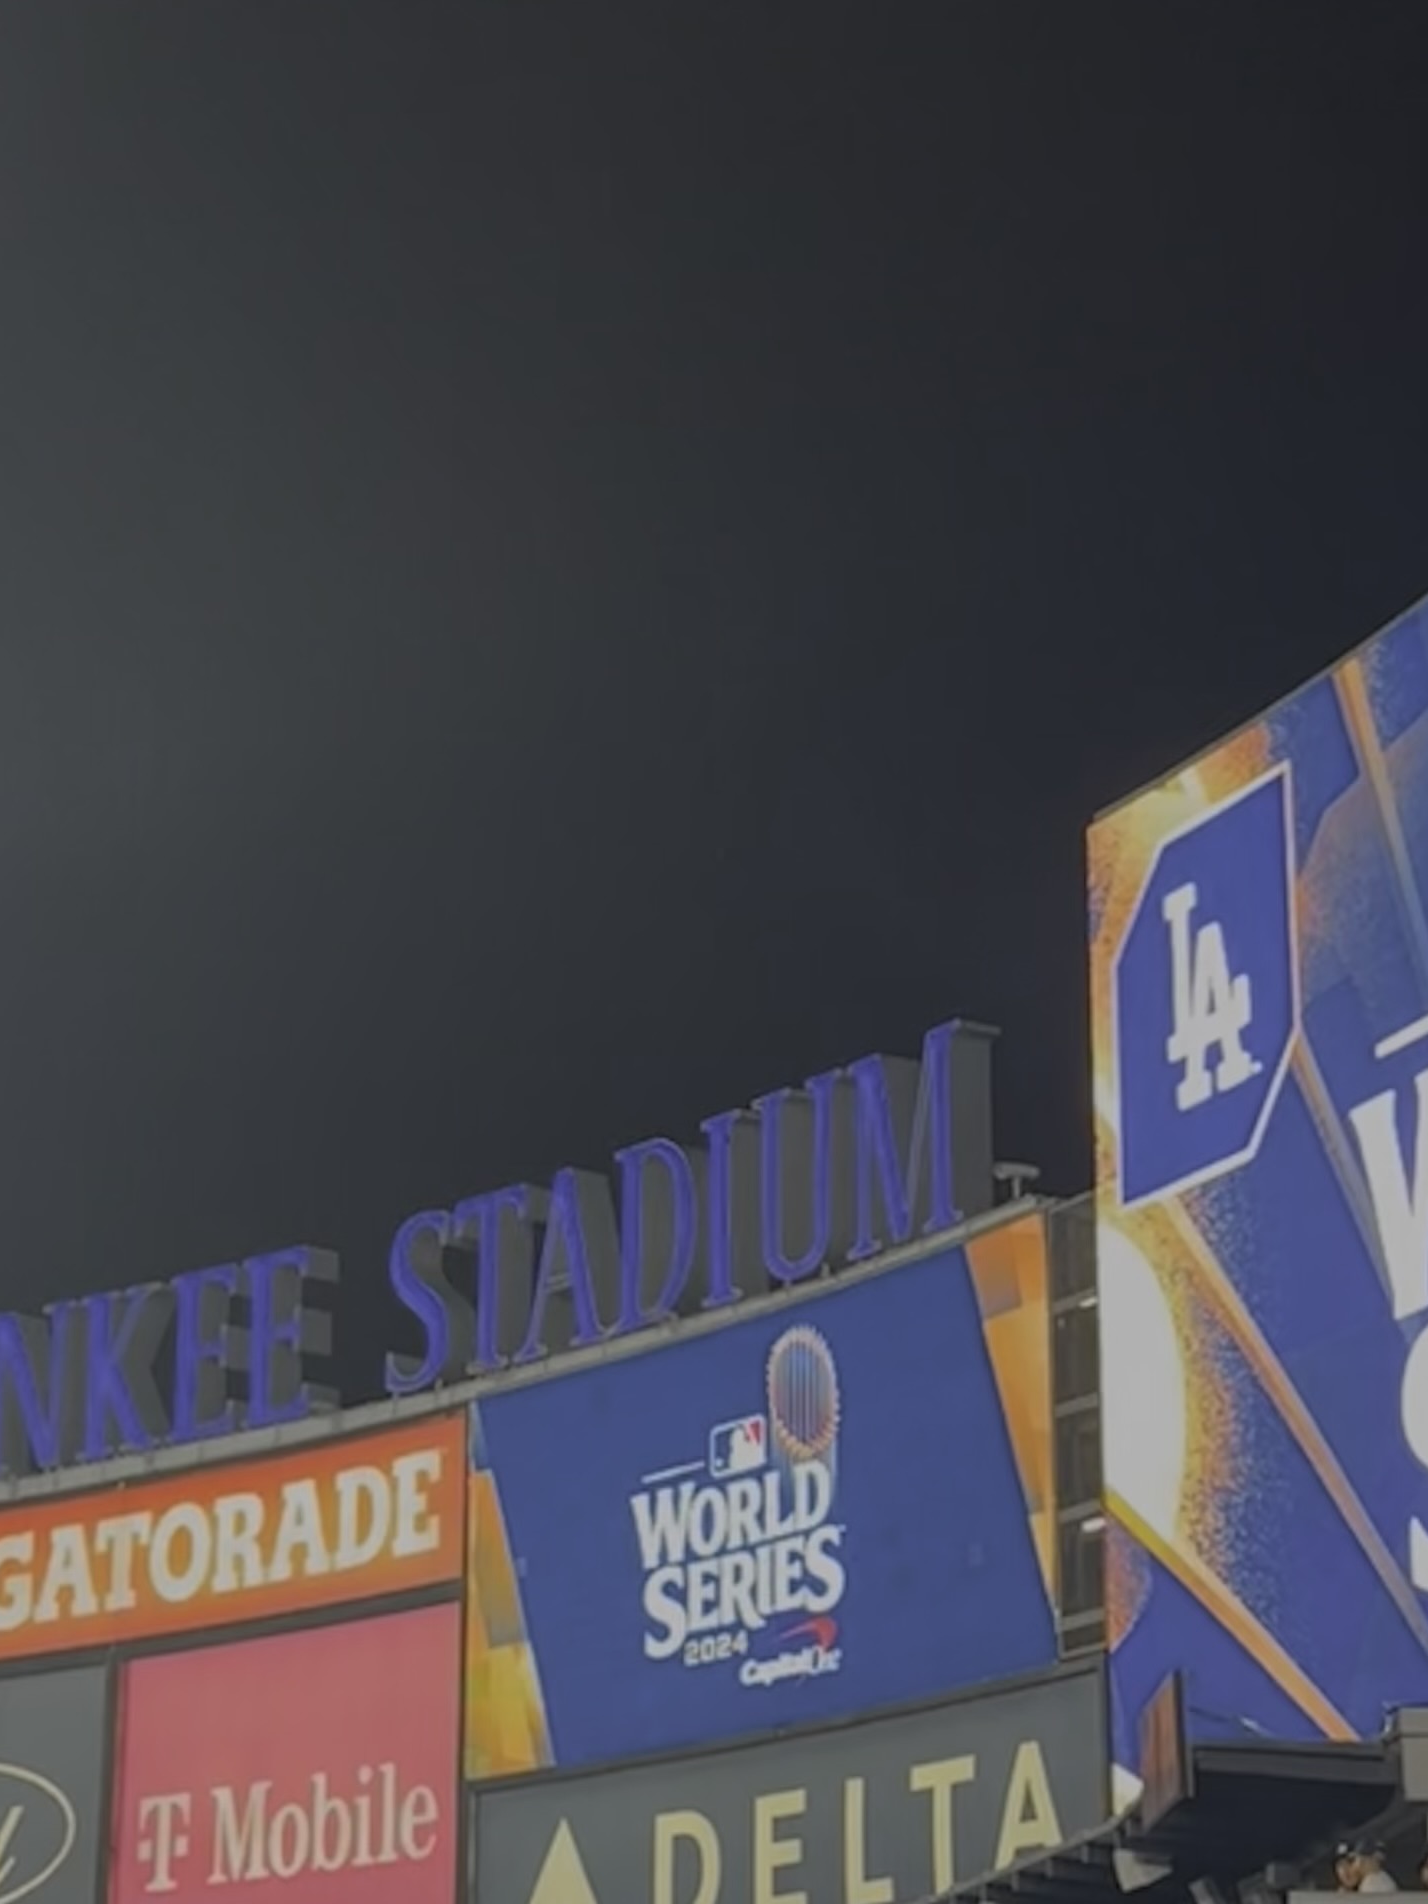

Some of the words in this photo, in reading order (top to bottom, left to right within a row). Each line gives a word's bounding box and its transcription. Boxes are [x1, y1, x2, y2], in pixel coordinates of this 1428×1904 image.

[1163, 882, 1263, 1112] LA
[384, 1017, 972, 1394] STADIUM
[630, 1459, 834, 1571] WORLD
[642, 1530, 846, 1660] SERIES
[683, 1630, 749, 1666] 2024
[206, 1762, 438, 1884] Mobile
